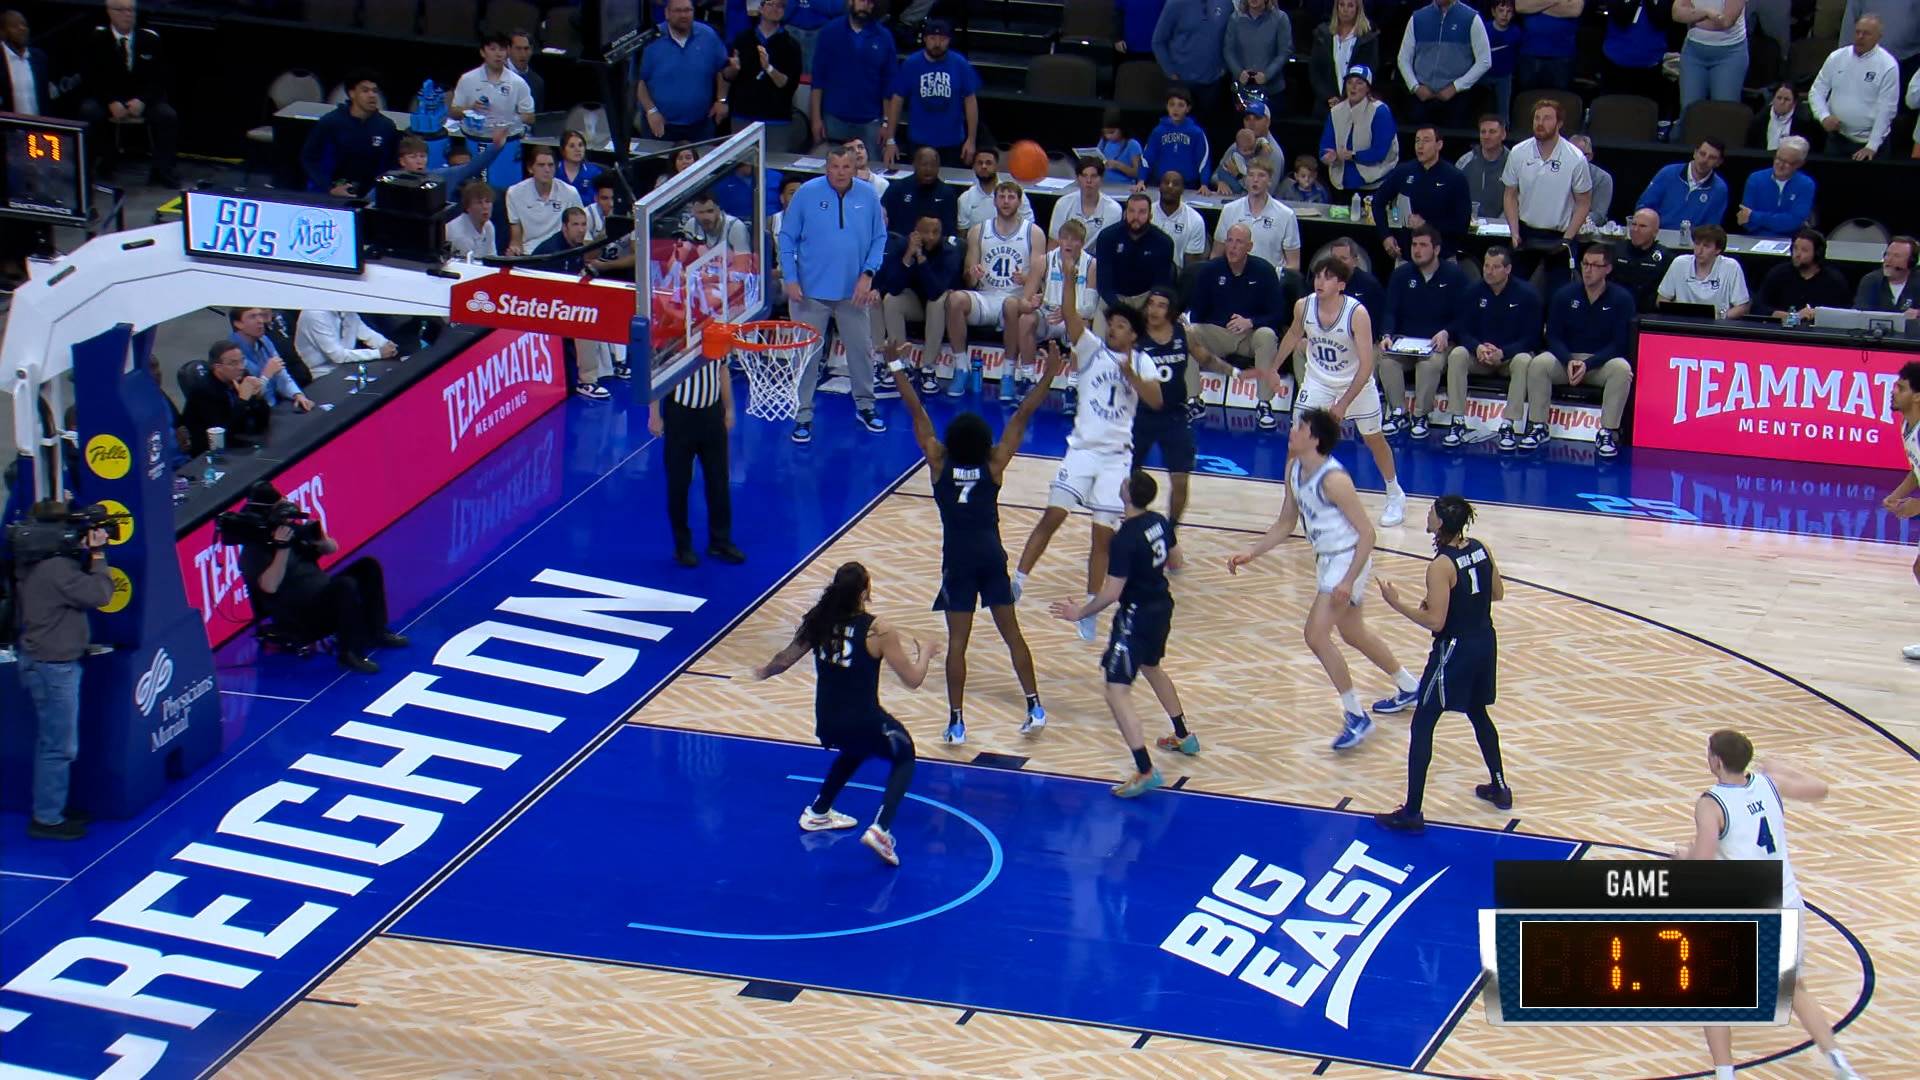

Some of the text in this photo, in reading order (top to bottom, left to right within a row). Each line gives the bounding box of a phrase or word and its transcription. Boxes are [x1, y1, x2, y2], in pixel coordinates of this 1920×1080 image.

[920, 71, 951, 87] FEAR
[920, 84, 952, 98] BEARD
[217, 199, 259, 229] GO
[201, 225, 277, 257] JAYS
[289, 219, 337, 254] Matt
[984, 246, 1023, 264] CREIGHTON
[992, 257, 1010, 277] 41
[1317, 345, 1337, 362] 10
[443, 331, 554, 453] TEAMMATES
[1108, 386, 1116, 407] 1
[1669, 357, 1900, 425] TEAMMAT
[475, 390, 528, 437] MENTORING
[1737, 417, 1880, 444] MENTORING
[954, 480, 978, 504] 7
[1576, 492, 1700, 521] 25
[1151, 538, 1167, 569] 3
[1468, 566, 1480, 595] 1
[162, 675, 213, 722] Physicians
[151, 706, 192, 753] Mutual
[1746, 800, 1765, 816] DIX
[0, 568, 708, 1080] CREIGHTON
[1757, 816, 1777, 855] 4
[1159, 853, 1307, 977] BIG
[1238, 839, 1410, 1008] EAST
